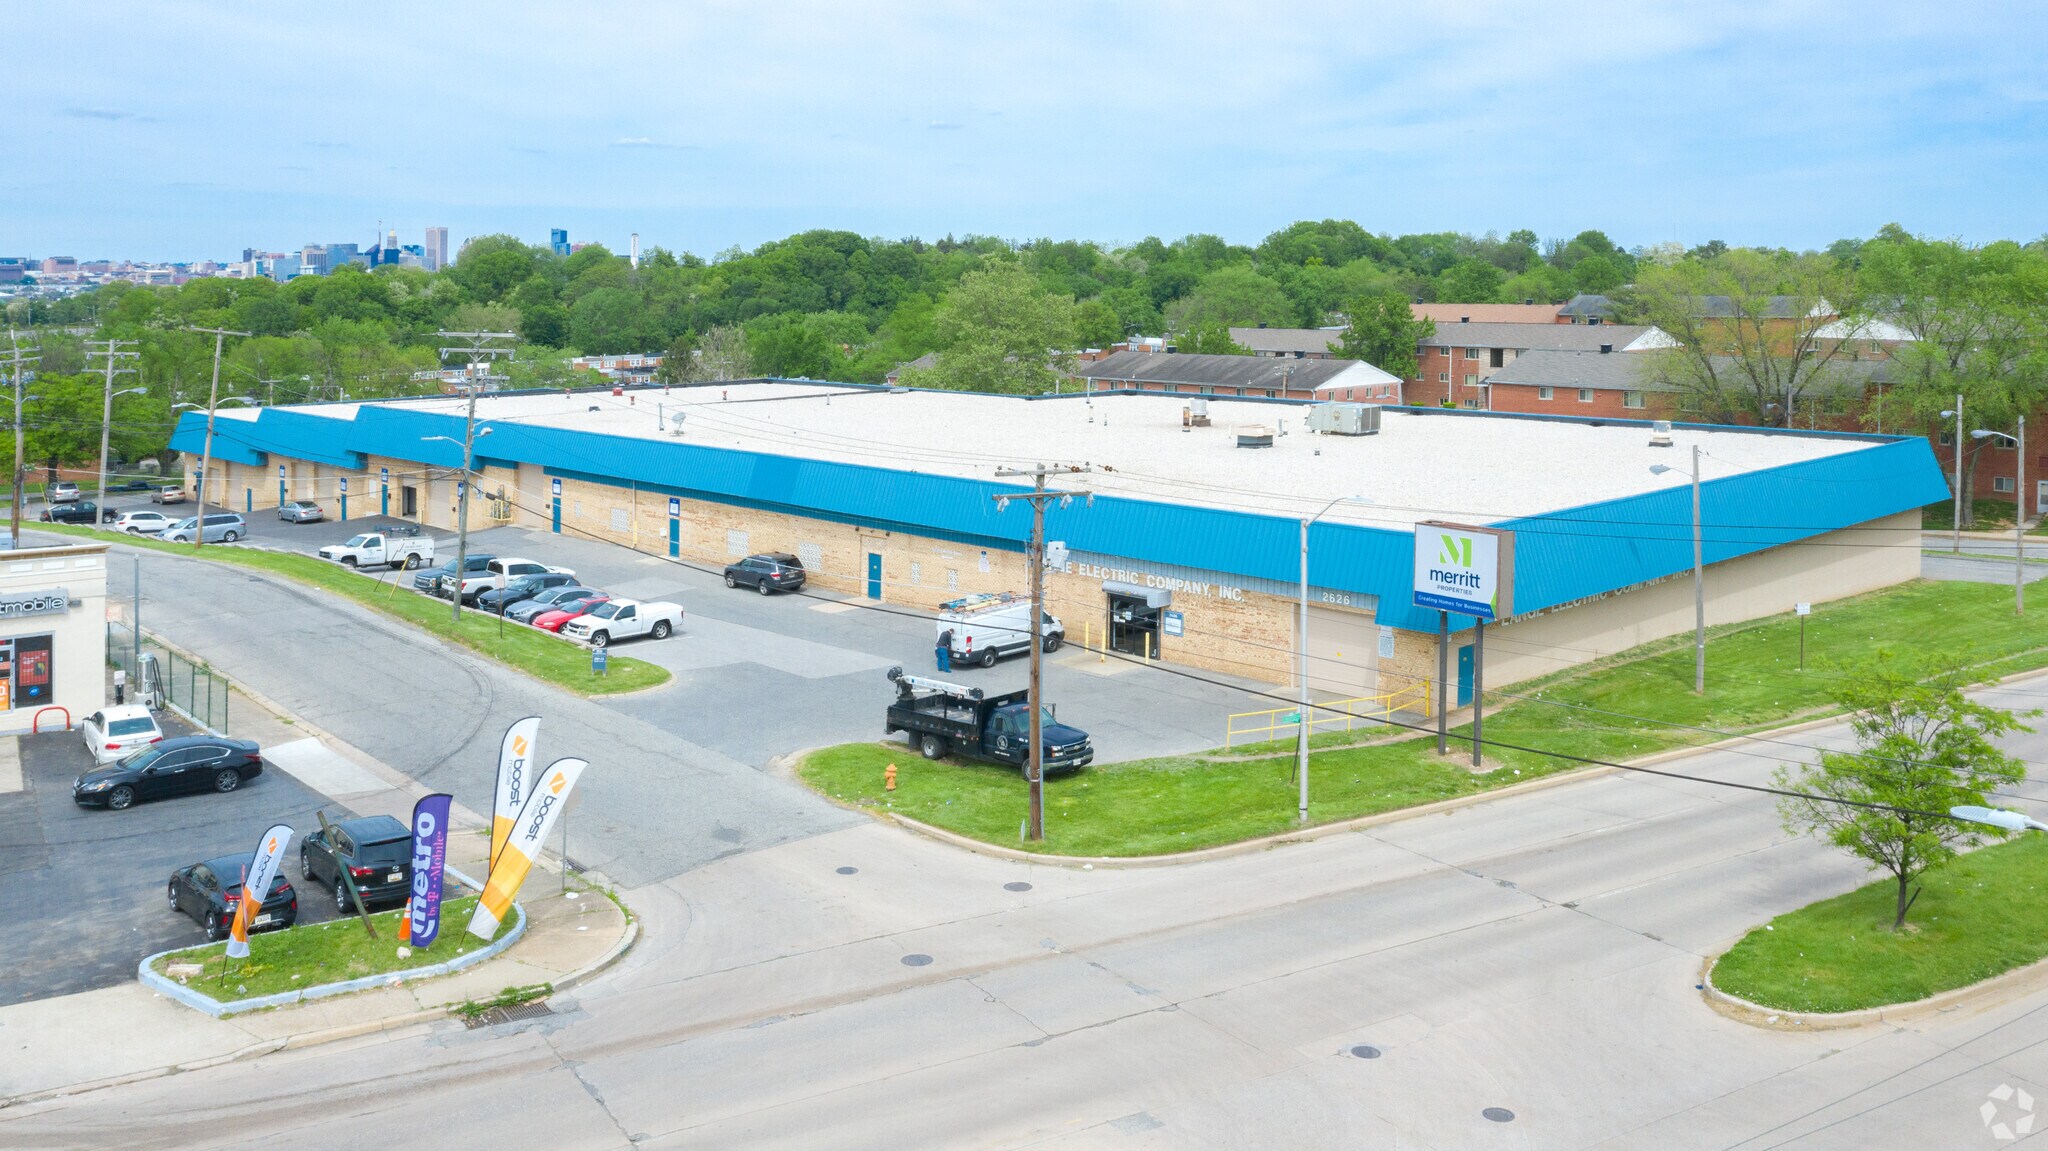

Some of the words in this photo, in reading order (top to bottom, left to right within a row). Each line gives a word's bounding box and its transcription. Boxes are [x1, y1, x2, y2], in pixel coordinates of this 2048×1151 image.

[1079, 563, 1139, 584] ELECTRIC
[1146, 574, 1212, 598] COMPANY,
[1218, 585, 1245, 602] INC.
[1429, 568, 1480, 589] merritt
[1322, 592, 1350, 605] 2626
[1436, 584, 1473, 596] PROPERTIES
[1418, 594, 1438, 604] Creating
[1438, 599, 1454, 607] Homes
[1464, 603, 1491, 613] Businesses
[509, 758, 526, 807] boost
[525, 795, 557, 842] boost
[412, 812, 435, 936] metro
[427, 906, 438, 917] by
